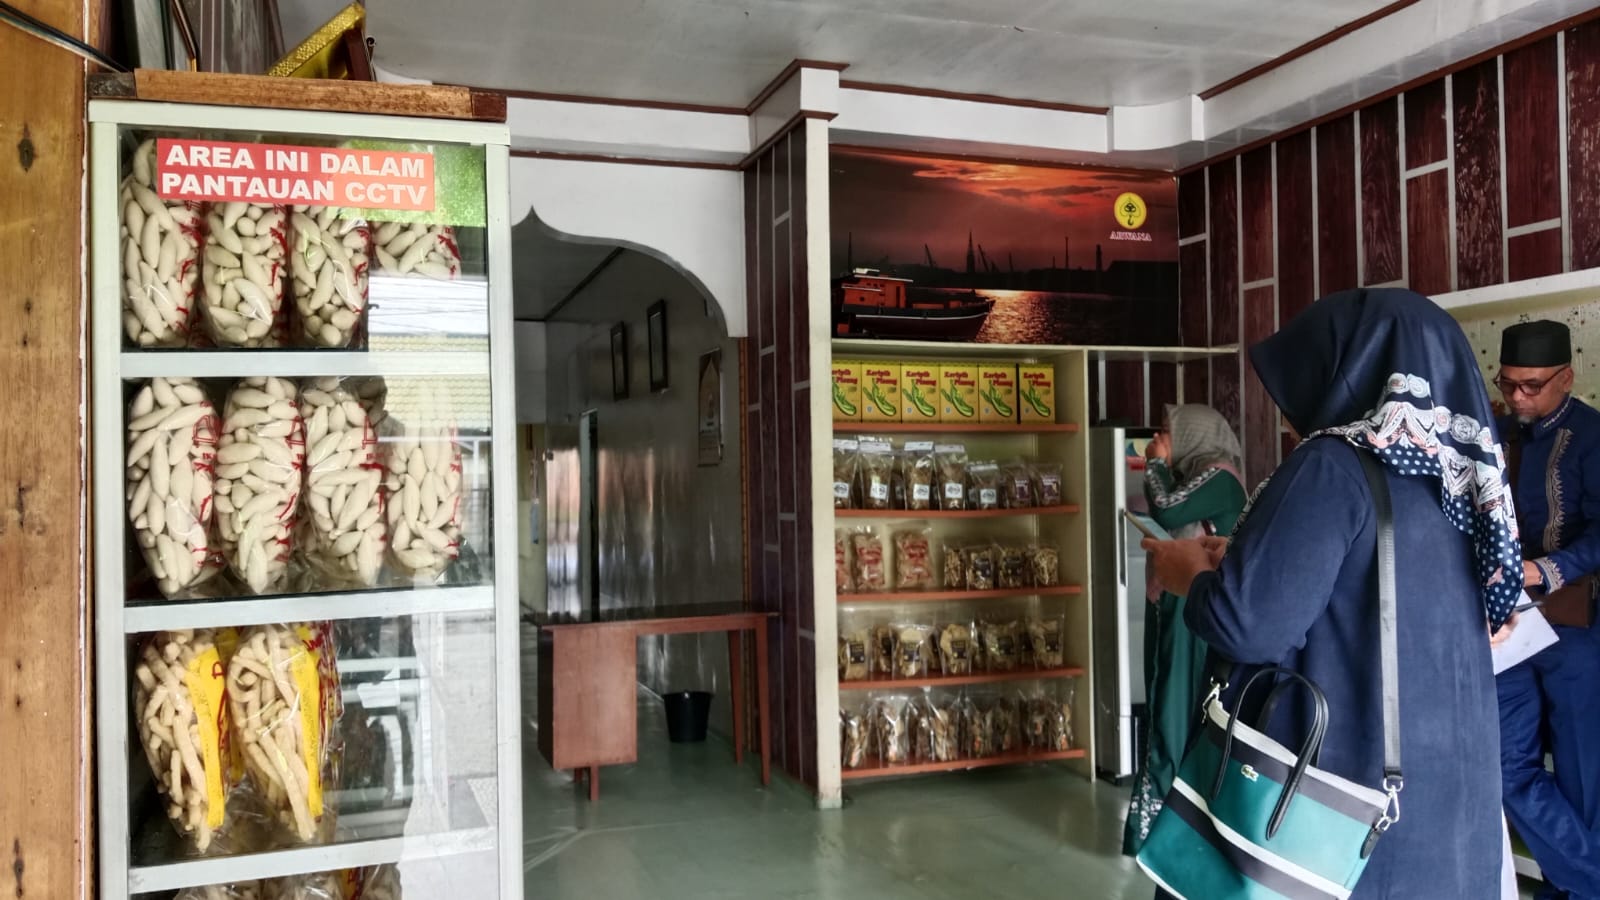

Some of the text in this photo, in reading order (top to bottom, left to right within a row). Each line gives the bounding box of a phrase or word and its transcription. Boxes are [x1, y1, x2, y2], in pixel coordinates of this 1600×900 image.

[165, 144, 425, 179] AREA INI DALAM
[162, 172, 428, 206] PANTAUAN CCTV
